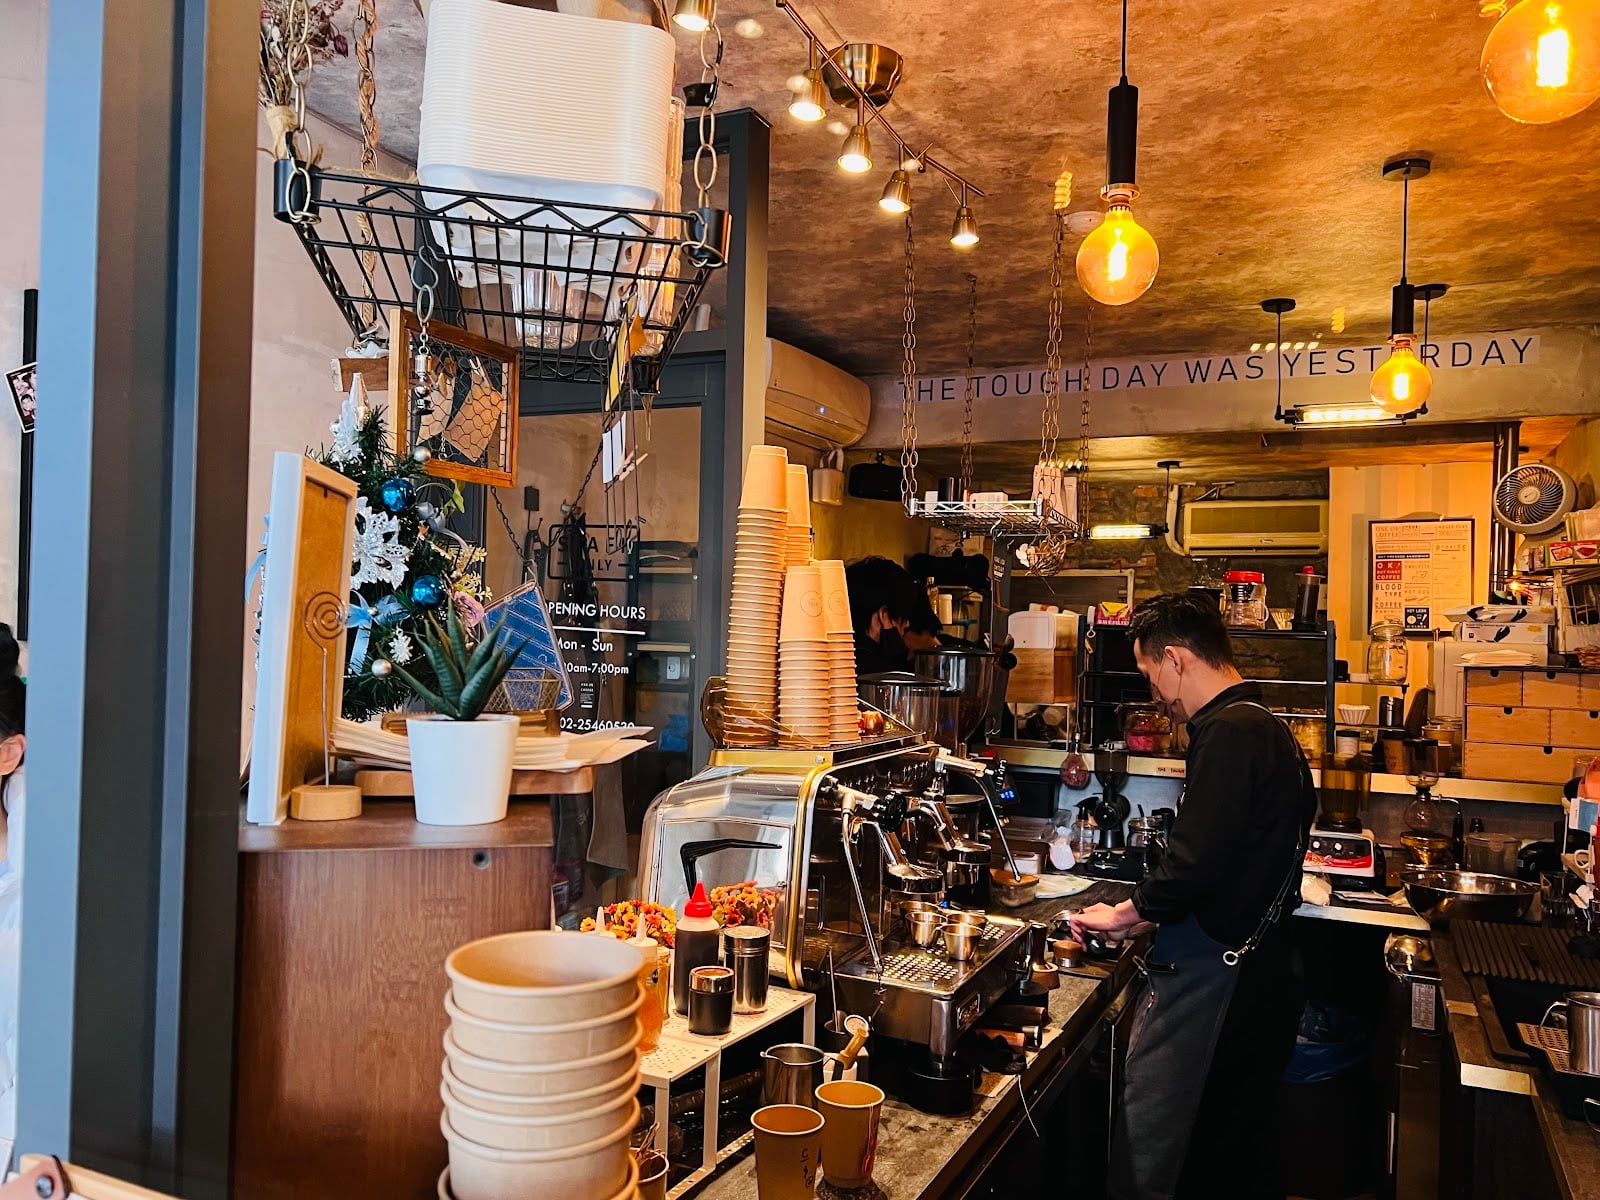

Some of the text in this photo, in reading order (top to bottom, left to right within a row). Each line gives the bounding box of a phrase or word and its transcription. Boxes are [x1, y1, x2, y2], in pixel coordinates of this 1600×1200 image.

[1102, 364, 1168, 390] DAY
[1184, 355, 1265, 384] WAS
[1282, 337, 1533, 377] YESTRDAY
[1375, 583, 1402, 591] BLOOD
[545, 601, 646, 619] PENING HOURS
[592, 638, 613, 651] Sun
